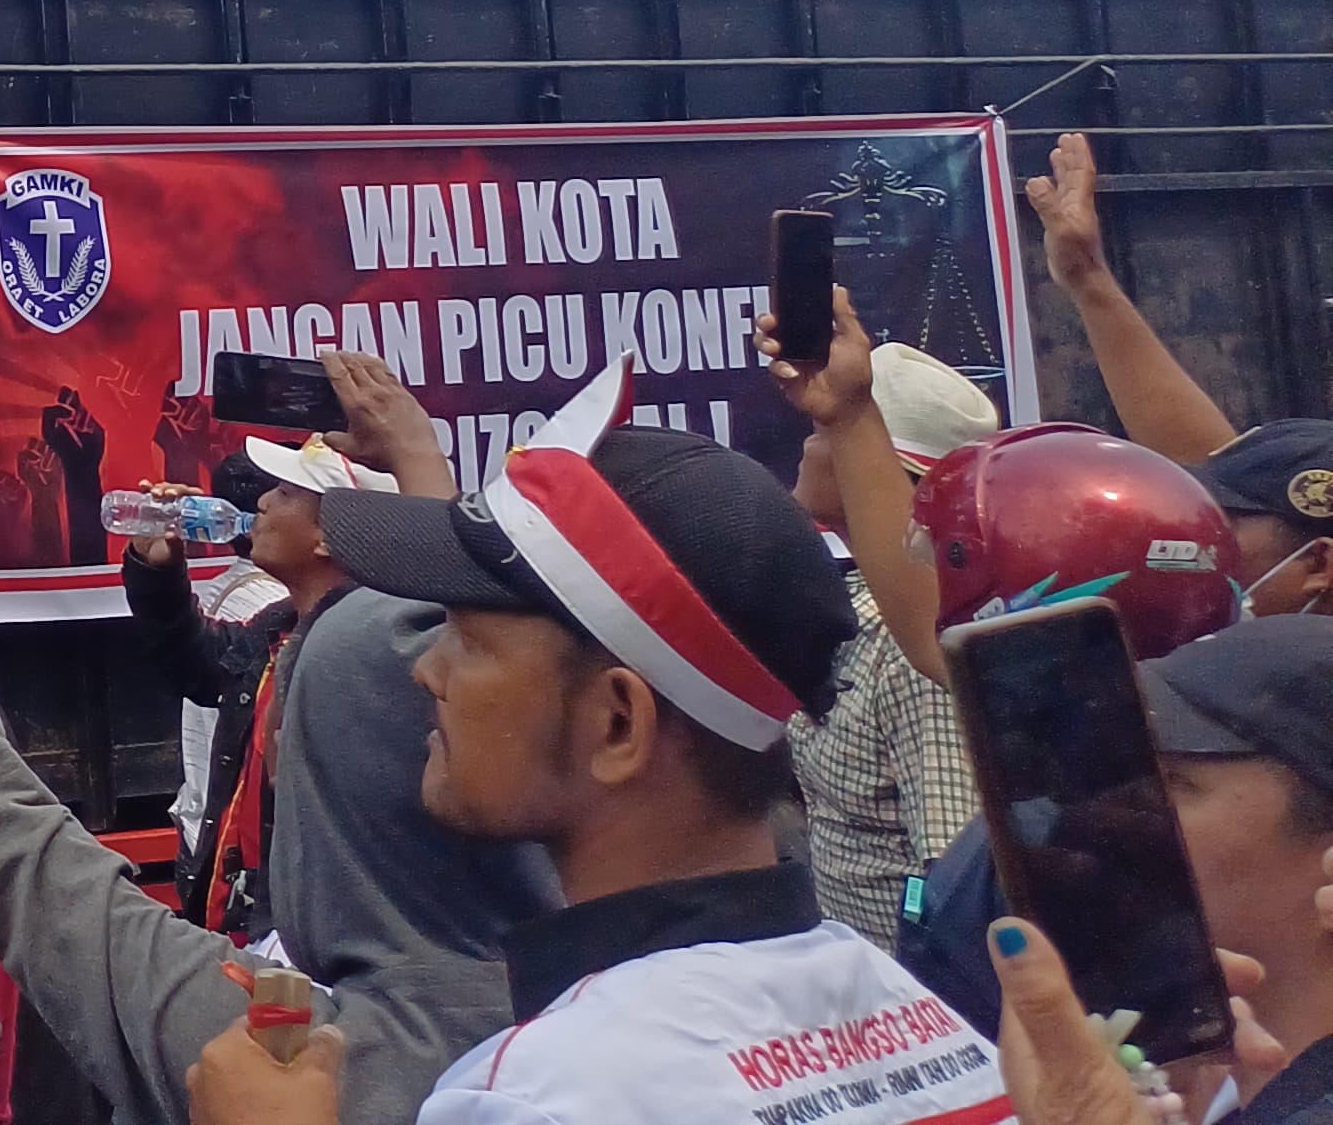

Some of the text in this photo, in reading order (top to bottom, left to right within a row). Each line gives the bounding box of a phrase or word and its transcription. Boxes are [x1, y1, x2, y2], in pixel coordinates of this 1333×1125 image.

[11, 174, 84, 198] GAMKI
[341, 177, 681, 270] WALI KOTA
[2, 259, 106, 323] ORA ET LABORA
[437, 293, 589, 385] PICU
[726, 1029, 828, 1092] HORAS
[818, 1008, 909, 1070] BANGSO
